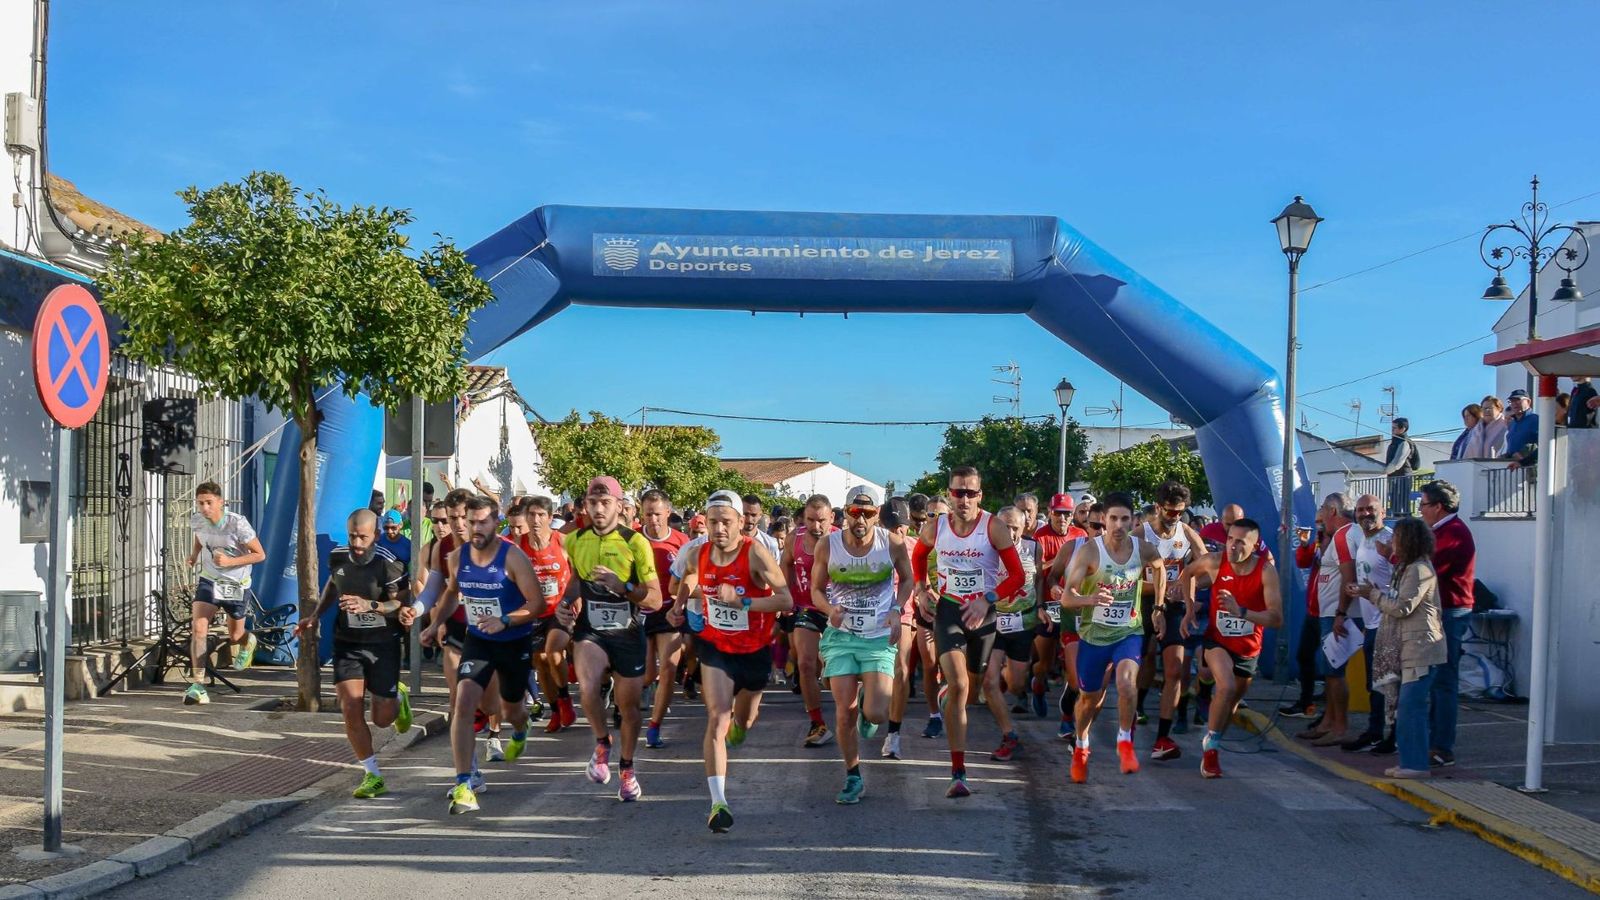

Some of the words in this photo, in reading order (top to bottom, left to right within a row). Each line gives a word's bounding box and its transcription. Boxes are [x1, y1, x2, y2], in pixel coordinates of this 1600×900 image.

[649, 241, 870, 260] Ayuntamiento
[878, 245, 915, 259] de
[922, 245, 1000, 263] Jerez
[649, 259, 752, 272] Deportes
[954, 577, 977, 587] 335
[471, 606, 493, 616] 336
[601, 610, 617, 621] 37
[714, 607, 738, 621] 216
[1103, 608, 1125, 618] 333
[356, 613, 377, 622] 165
[849, 616, 864, 626] 15
[1225, 620, 1246, 629] 217
